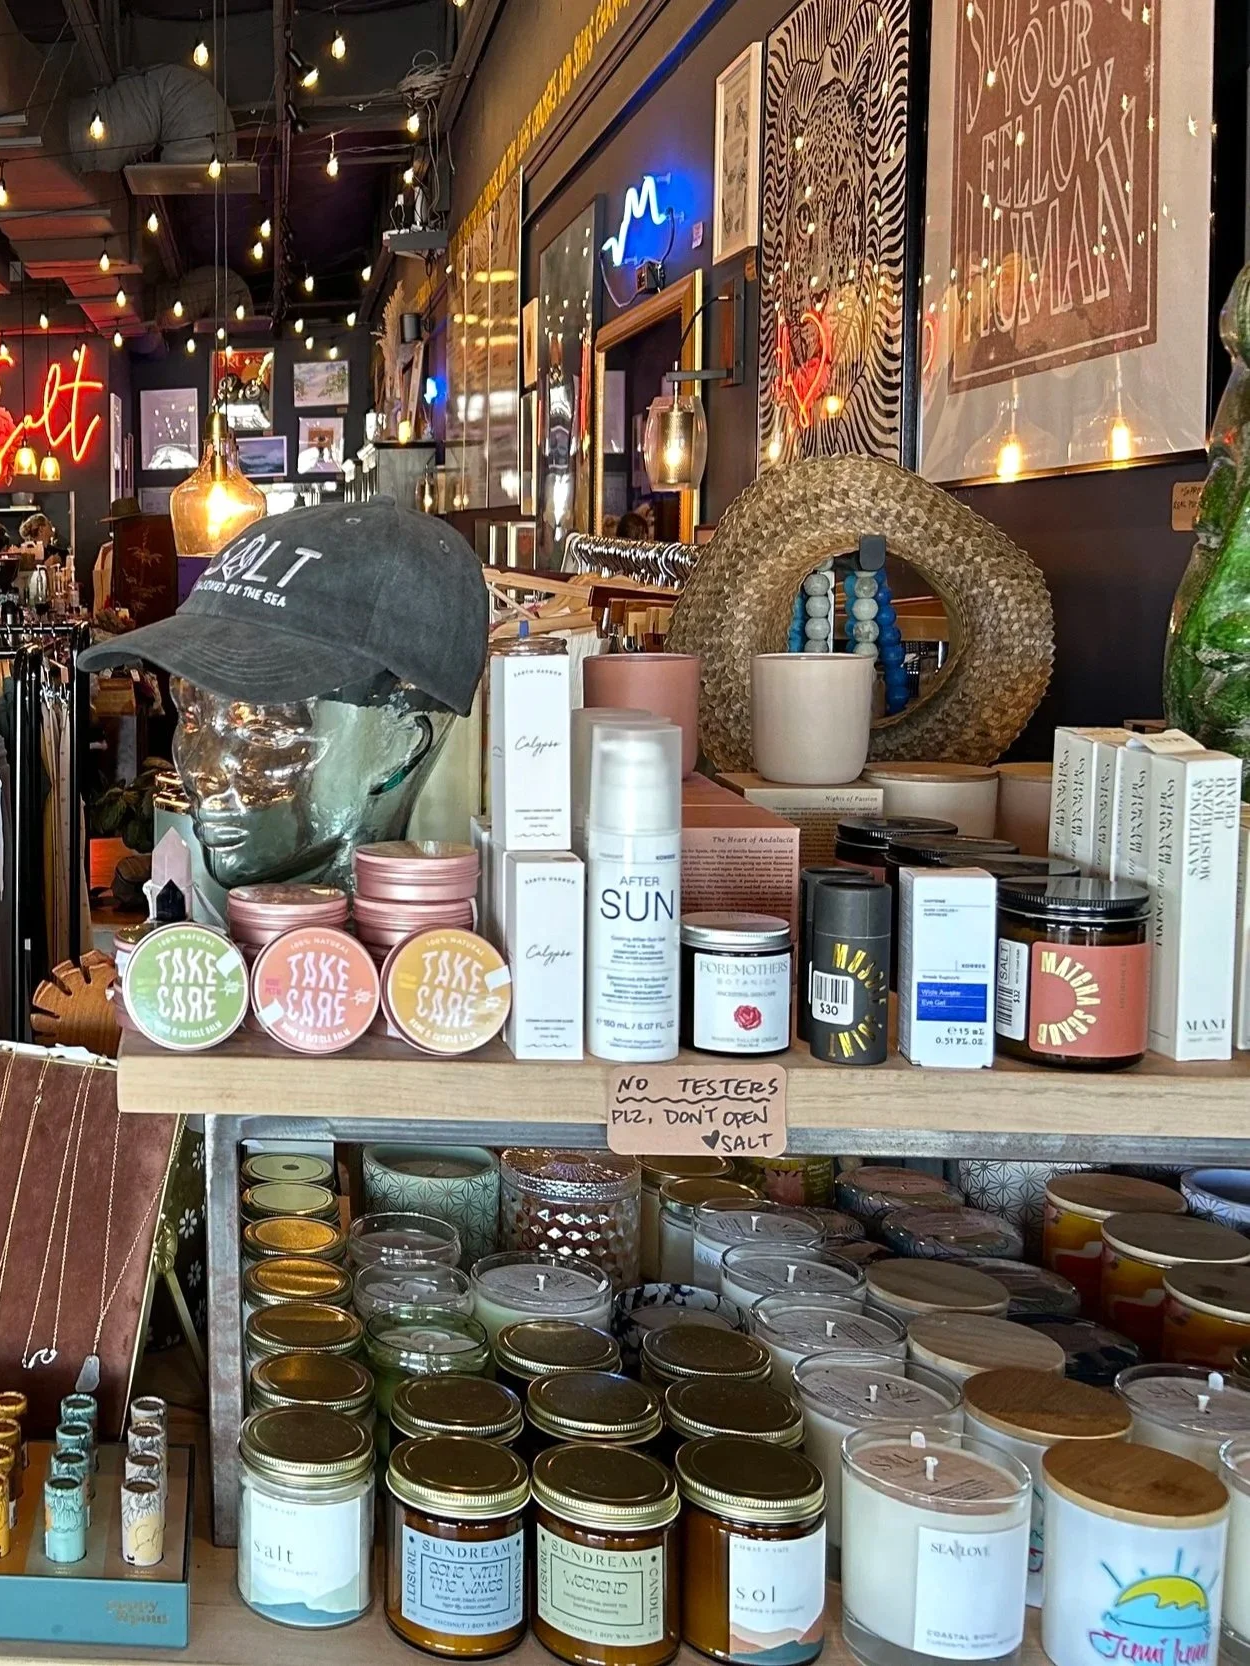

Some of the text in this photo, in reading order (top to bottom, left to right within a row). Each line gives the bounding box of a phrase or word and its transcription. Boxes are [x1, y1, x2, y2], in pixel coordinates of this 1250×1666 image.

[1000, 1, 1093, 118] YOUR
[980, 57, 1115, 208] FELLOW
[963, 97, 1137, 342] HUMAN
[226, 583, 286, 608] BY THE SEA
[1214, 777, 1226, 821] HAND
[1187, 791, 1202, 877] SANITIZING
[1199, 778, 1214, 881] MOISTURIZING
[619, 876, 660, 887] AFTER
[600, 889, 674, 922] SUN
[156, 947, 217, 985] TAKE
[286, 951, 350, 991] TAKE
[422, 950, 484, 994] TAKE
[699, 960, 788, 976] FOREMOTHERS
[999, 946, 1010, 980] SALT
[1041, 951, 1101, 1005] MATCHA
[157, 985, 217, 1023] CARE
[286, 988, 347, 1028] CARE
[416, 985, 478, 1028] CARE
[819, 1002, 838, 1016] $30
[1037, 1009, 1097, 1046] SCRUB
[1185, 1019, 1227, 1032] MANI
[617, 1075, 779, 1095] NO TESTERS
[663, 1104, 719, 1125] DON'T
[723, 1106, 768, 1128] OPEN
[720, 1133, 773, 1153] SALT
[422, 1539, 511, 1559] SUNDREAM
[551, 1540, 643, 1568] SUNDREAM
[930, 1542, 990, 1557] SEA LOVE
[406, 1547, 417, 1604] LEISURE
[462, 1578, 503, 1594] WAVES
[470, 1563, 504, 1579] WITH
[513, 1551, 522, 1607] CANDLE
[540, 1548, 548, 1603] LEISURE
[649, 1568, 659, 1624] CANDLE
[736, 1585, 775, 1603] sol
[927, 1629, 969, 1641] COASTAL
